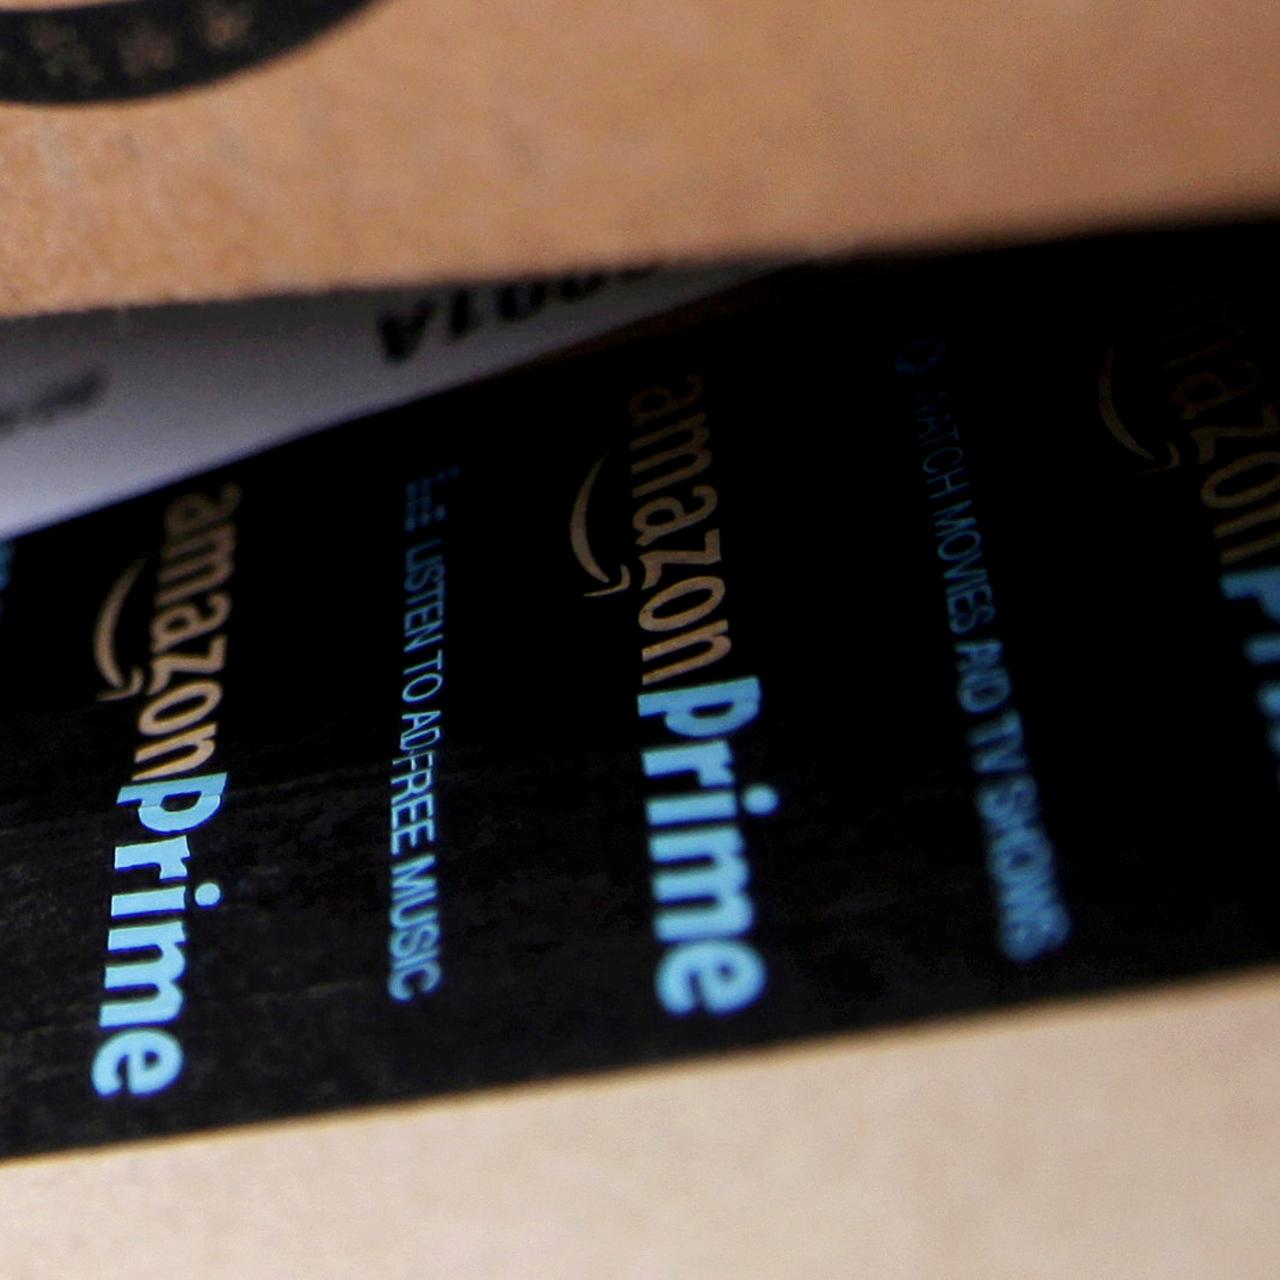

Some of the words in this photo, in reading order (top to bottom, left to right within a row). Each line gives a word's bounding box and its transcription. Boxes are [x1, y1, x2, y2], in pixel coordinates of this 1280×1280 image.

[403, 538, 446, 655] LISTEN
[934, 500, 997, 636] MOVIES
[401, 647, 444, 706] TO
[387, 853, 445, 1005] MUSIC
